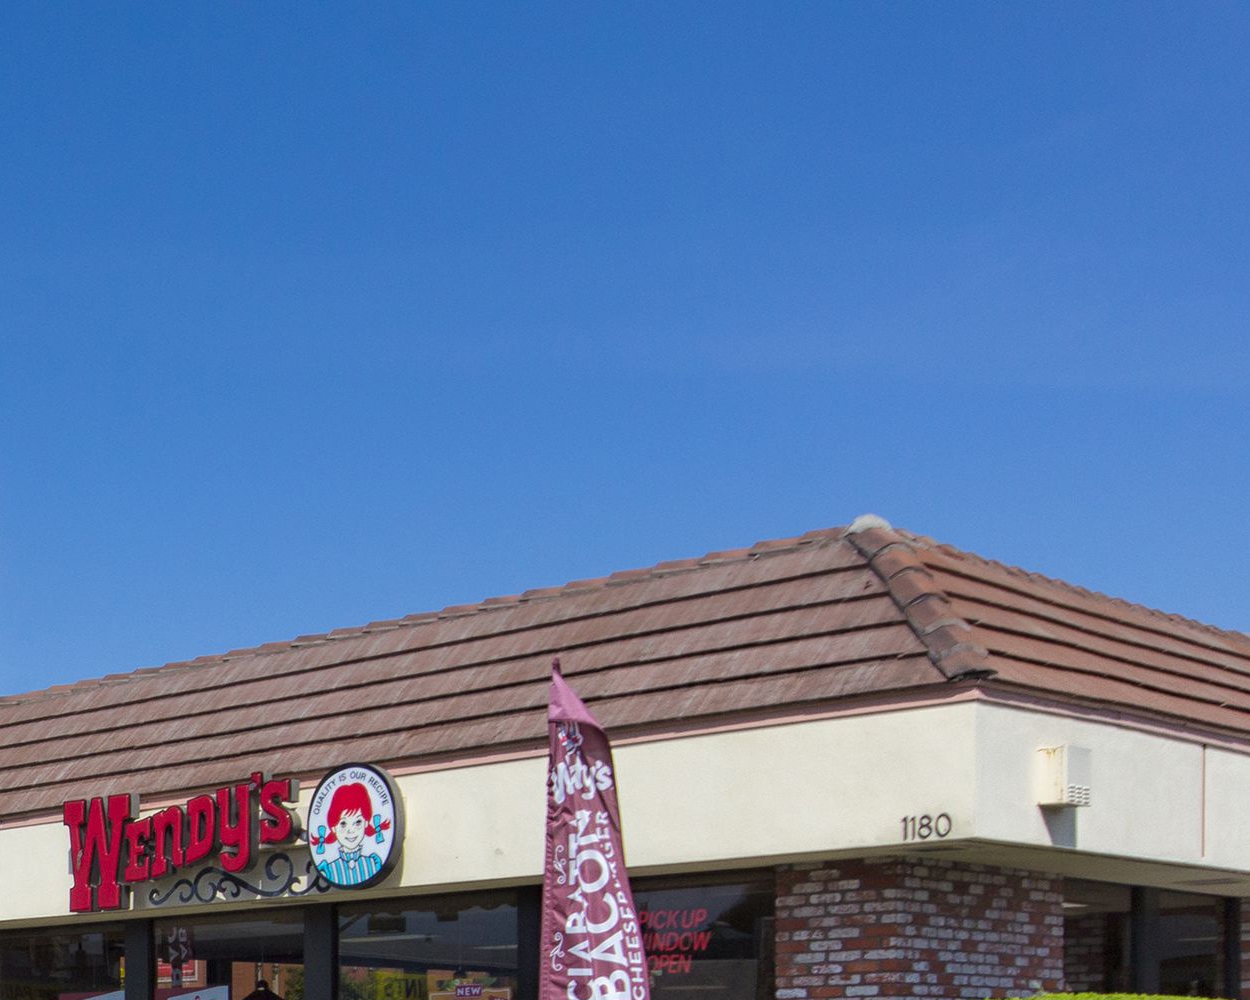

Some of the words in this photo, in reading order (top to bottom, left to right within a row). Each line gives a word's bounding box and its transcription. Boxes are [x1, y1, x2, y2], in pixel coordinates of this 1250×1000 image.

[313, 778, 336, 815] QUALITY
[339, 773, 347, 782] IS
[350, 771, 367, 781] OUR
[368, 776, 389, 806] RECIPE
[901, 813, 952, 841] 1180
[639, 910, 680, 929] PICK
[681, 908, 707, 929] UP
[644, 931, 711, 951] INDOW
[456, 986, 481, 996] NEW
